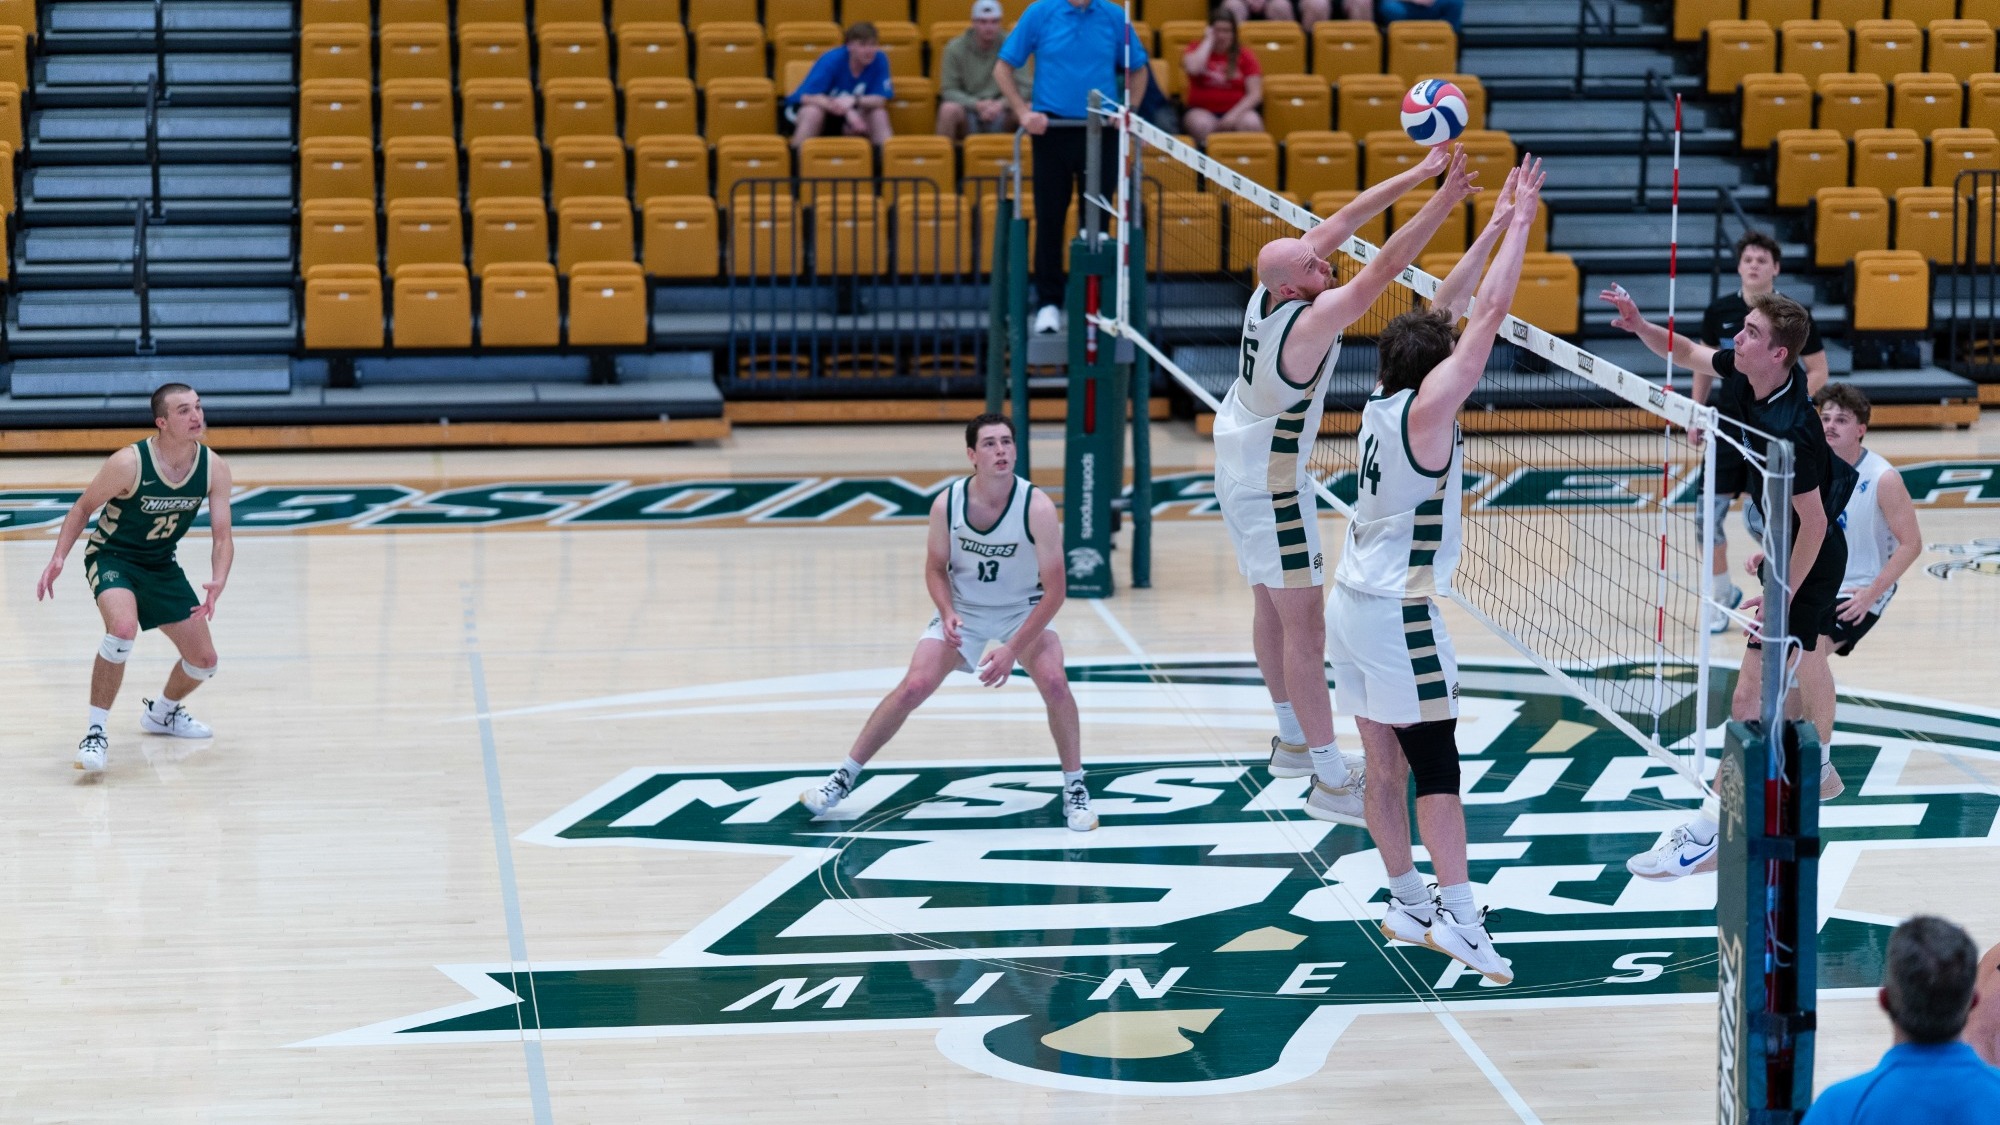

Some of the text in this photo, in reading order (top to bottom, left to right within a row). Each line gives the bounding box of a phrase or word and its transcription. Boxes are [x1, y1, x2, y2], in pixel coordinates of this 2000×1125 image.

[1243, 336, 1259, 386] 6
[1081, 453, 1095, 491] sports
[1359, 433, 1382, 496] 14
[145, 499, 197, 511] MINERS
[146, 512, 179, 540] 25
[962, 540, 1015, 556] MINERS
[977, 560, 1000, 583] 13
[720, 951, 1674, 1012] MINERS
[1720, 951, 1736, 1125] MINE
